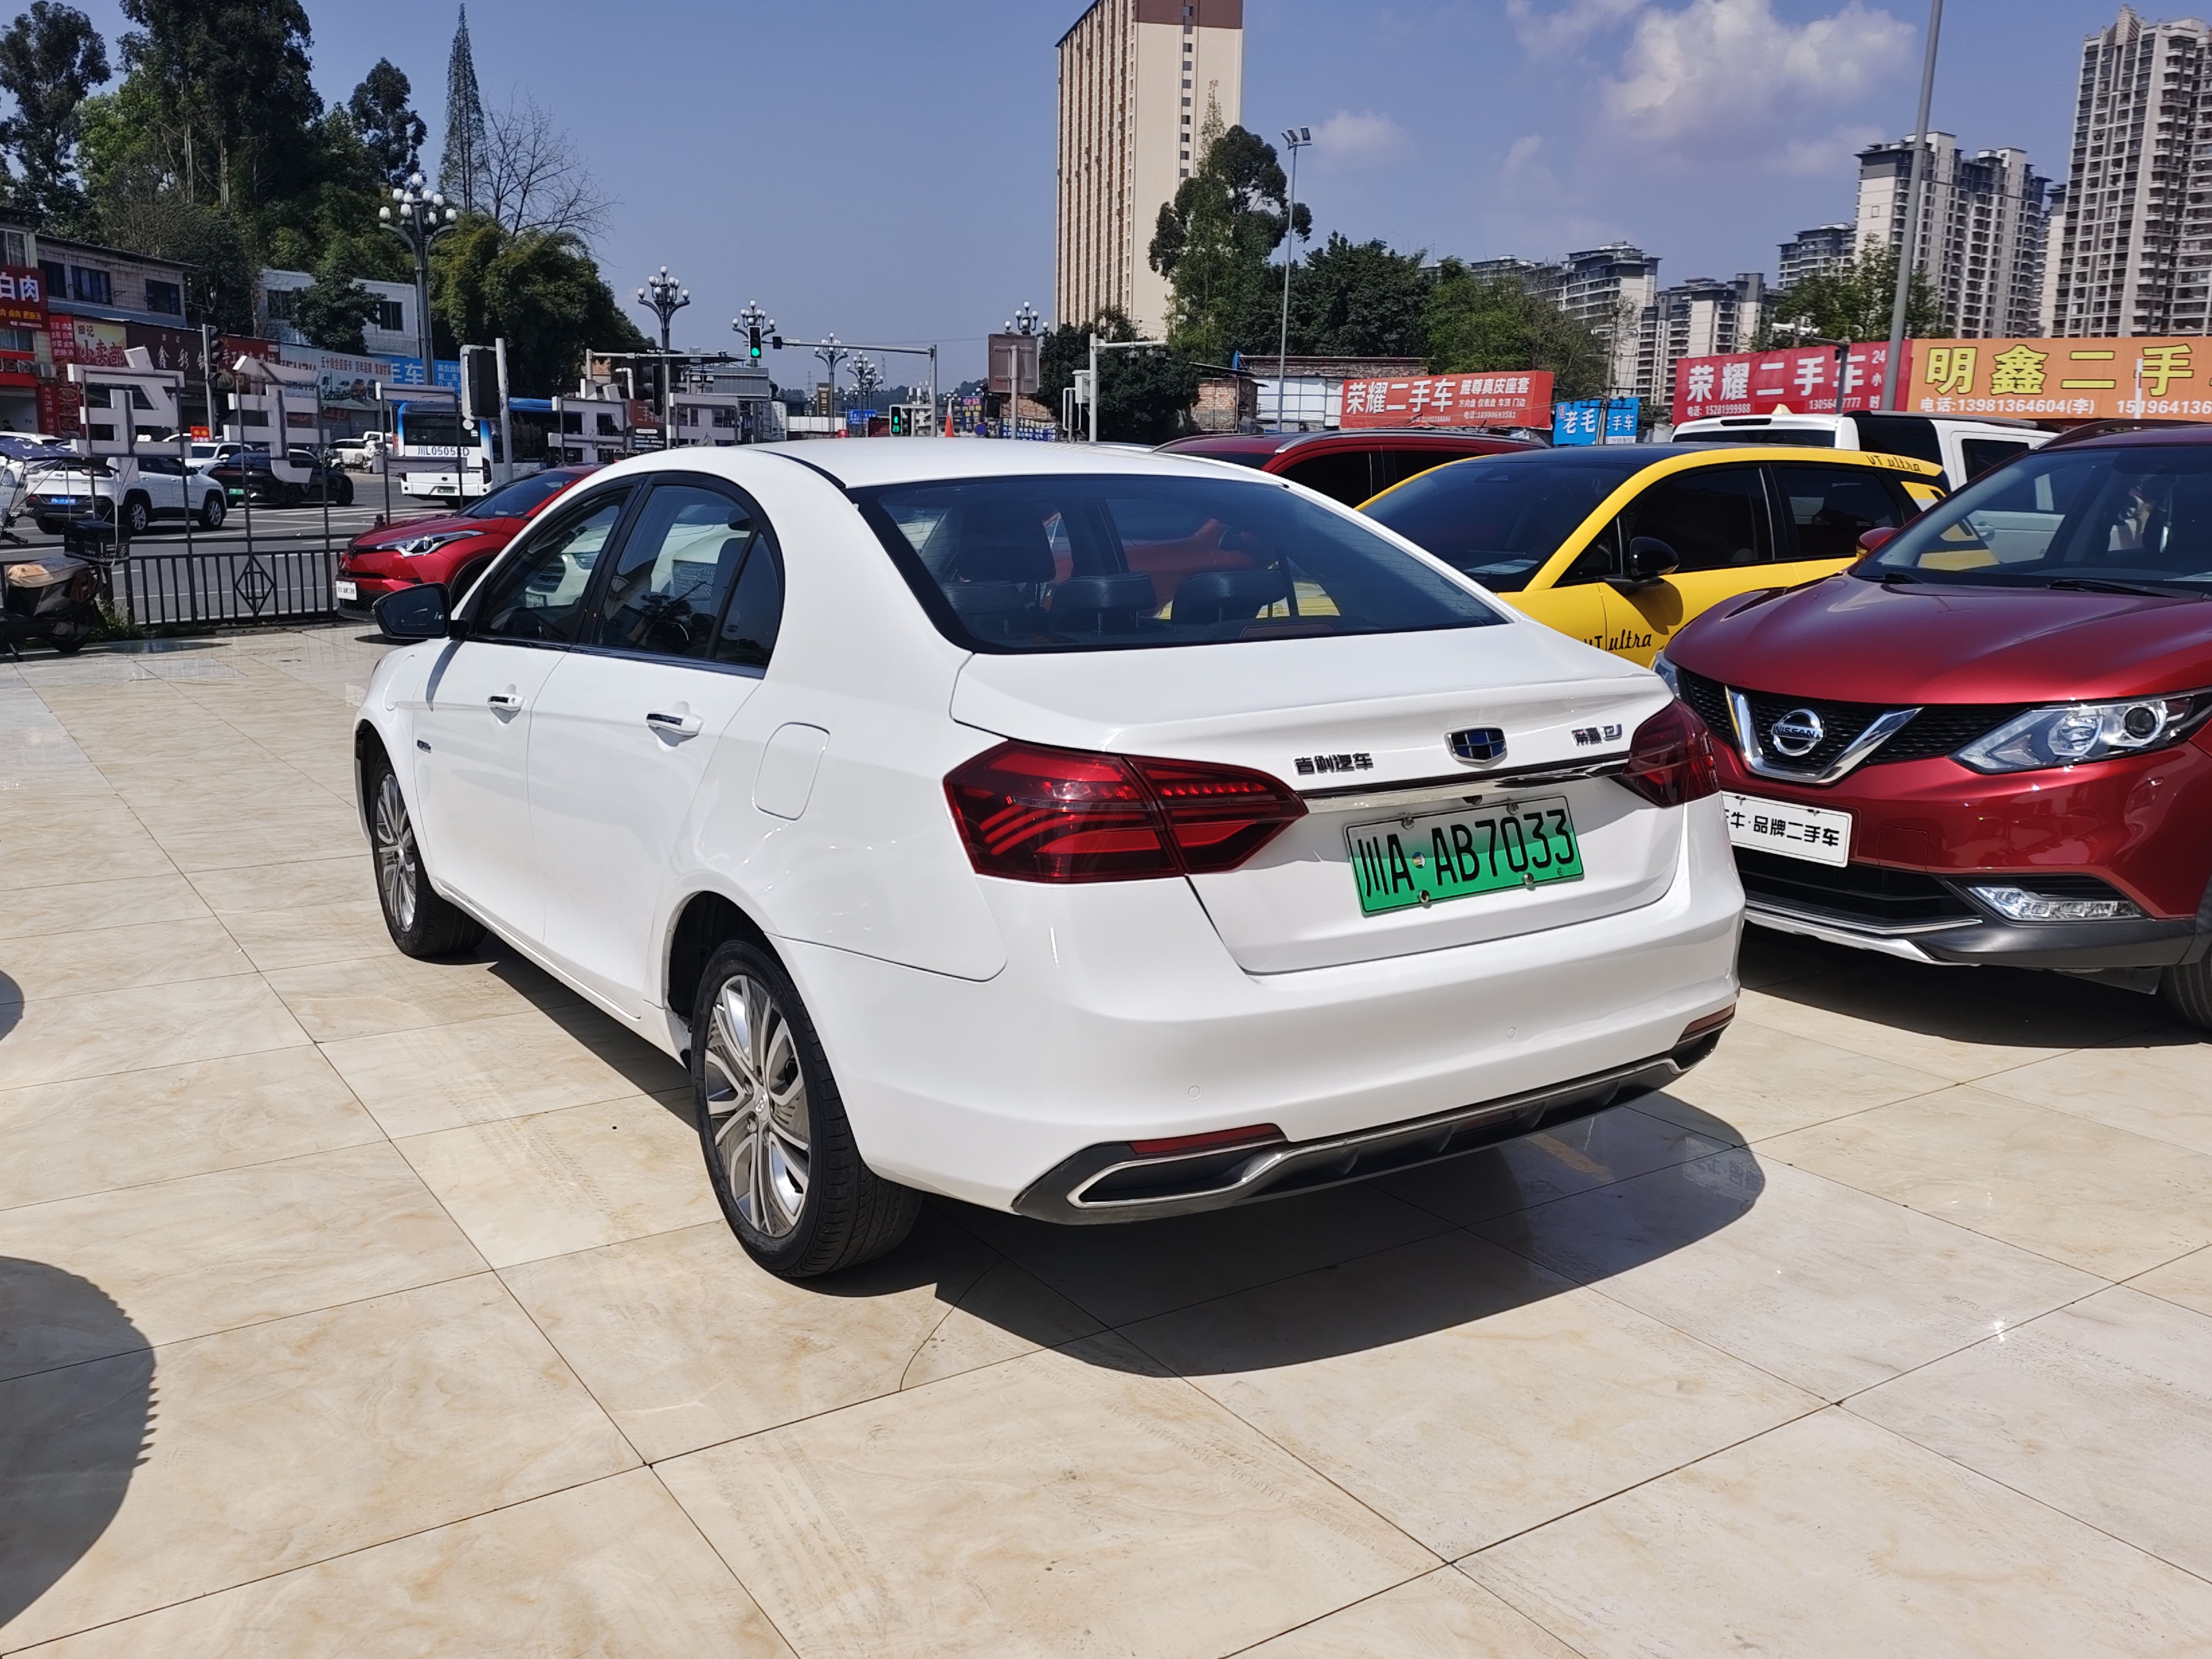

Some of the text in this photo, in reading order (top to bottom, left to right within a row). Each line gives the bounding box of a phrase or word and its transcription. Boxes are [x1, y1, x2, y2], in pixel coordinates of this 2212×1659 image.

[80, 339, 124, 367] 小卖部
[1687, 354, 1866, 402] 荣耀二手车
[1925, 344, 2212, 397] 明鑫二手
[1346, 378, 1456, 415] 荣耀二手车
[1809, 397, 1862, 410] 1305647777
[1562, 408, 1596, 434] 老毛
[418, 446, 470, 456] 川L0505D
[1887, 456, 1922, 472] ultra
[1608, 629, 1652, 651] ultra
[1774, 726, 1816, 739] NISSAN
[1294, 753, 1374, 776] 吉利汽车
[1725, 809, 1840, 847] 牛·品牌二手车
